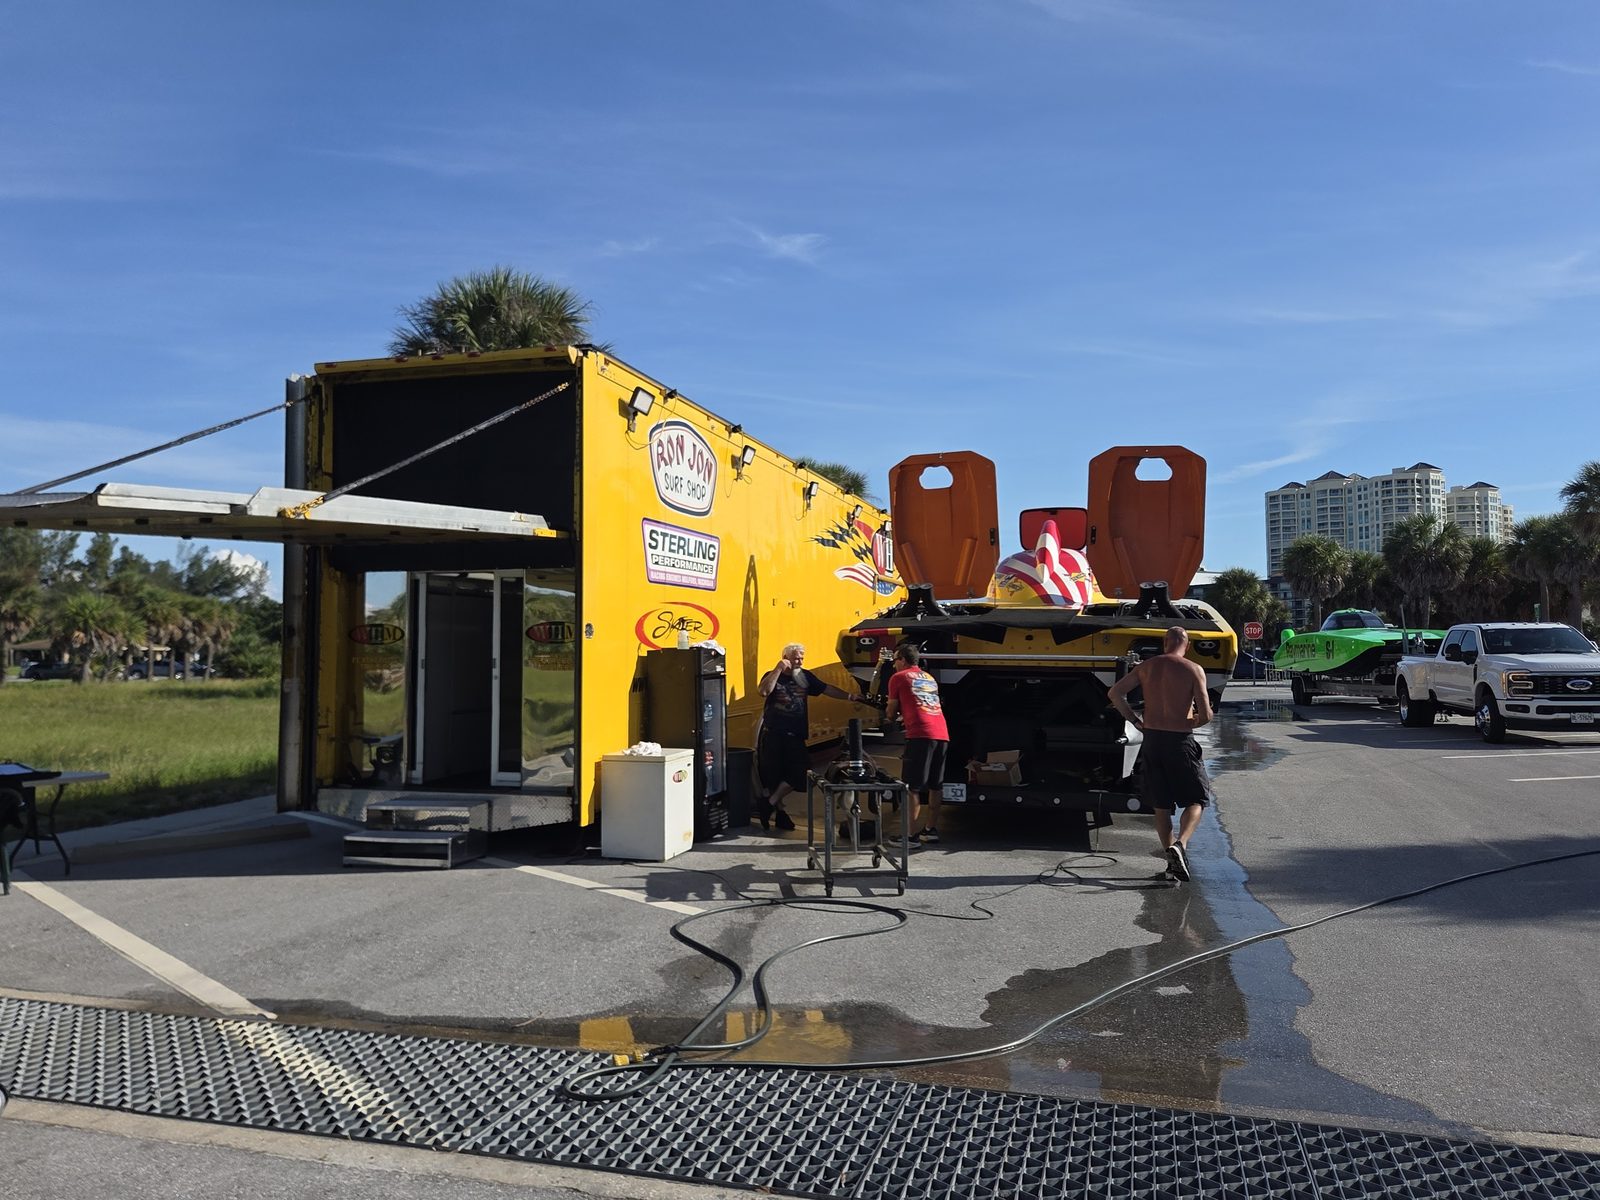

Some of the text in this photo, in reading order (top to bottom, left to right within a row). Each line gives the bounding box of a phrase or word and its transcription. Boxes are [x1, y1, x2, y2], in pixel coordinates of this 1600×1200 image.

[656, 433, 713, 485] RON JON
[665, 472, 706, 501] SURF SHOP
[648, 529, 717, 561] STERLING
[651, 554, 714, 574] PERFORMANCE
[1245, 627, 1262, 635] STOP
